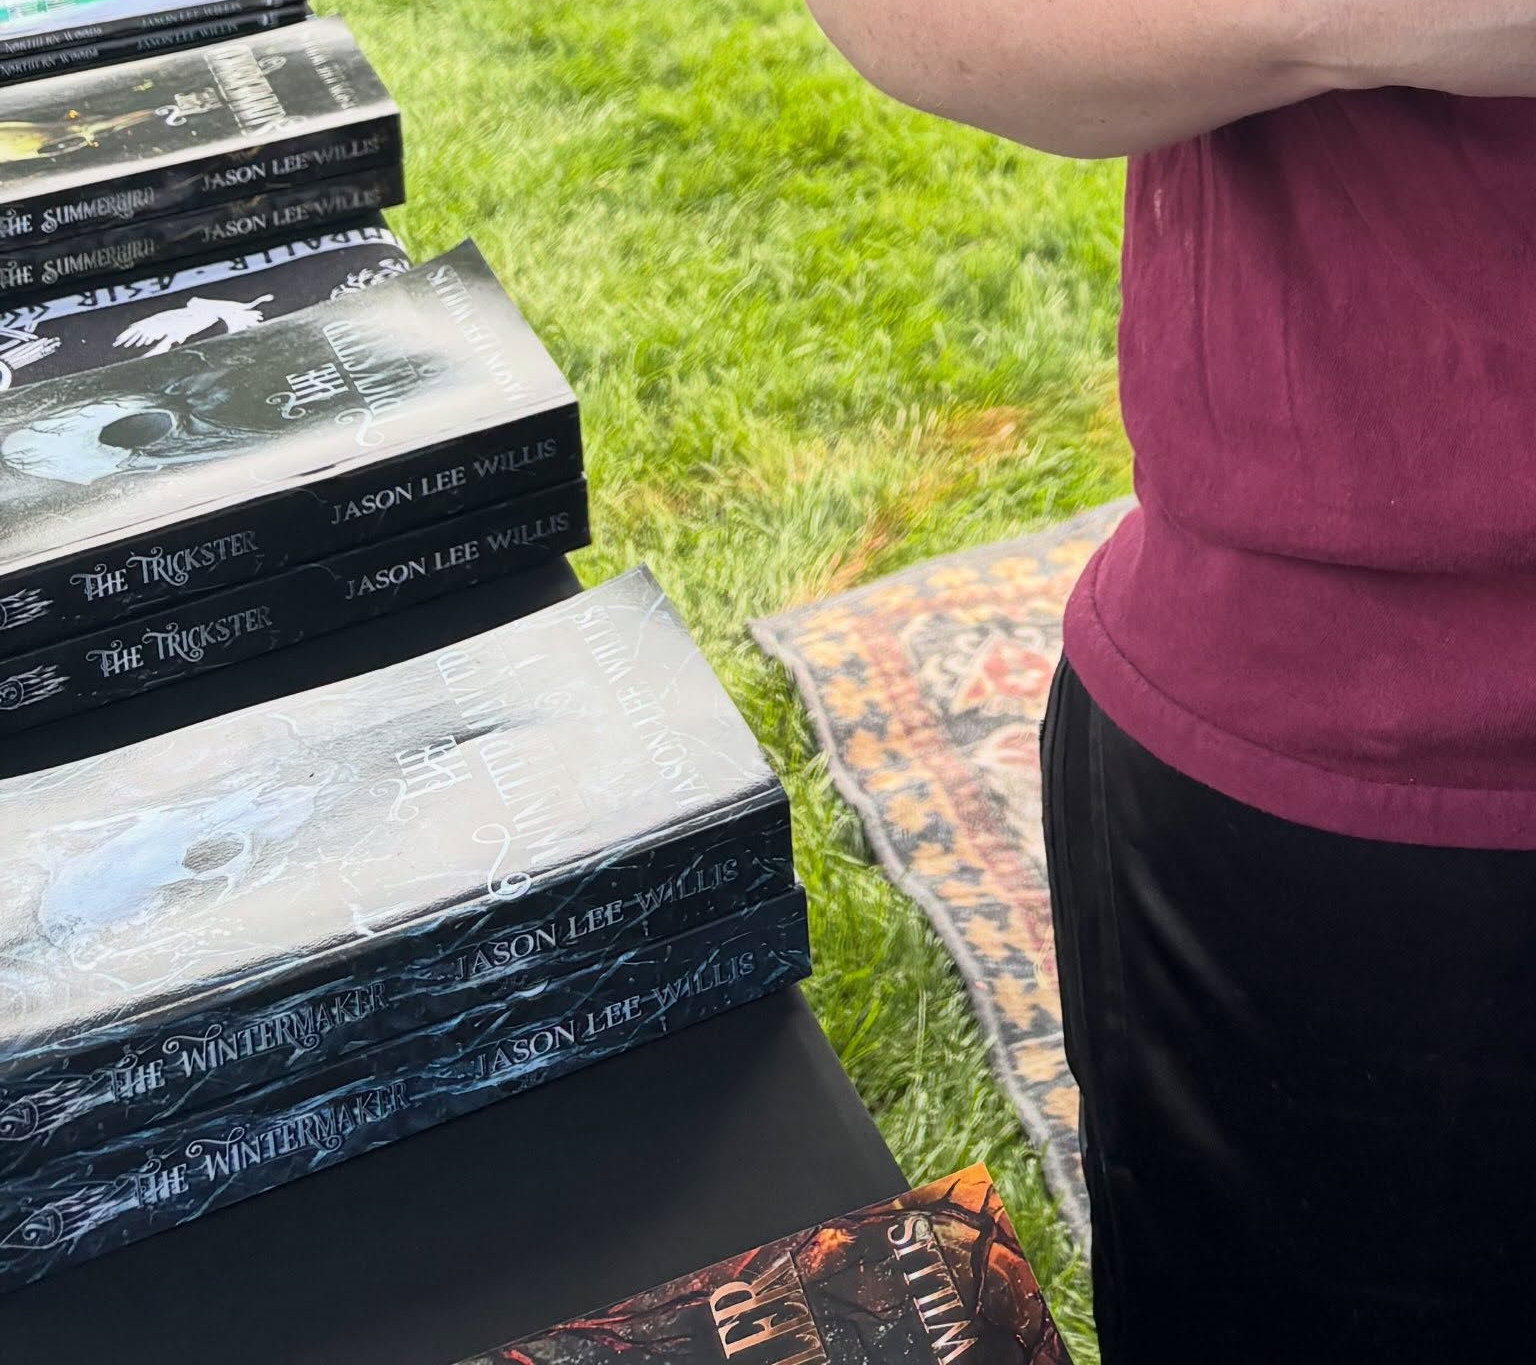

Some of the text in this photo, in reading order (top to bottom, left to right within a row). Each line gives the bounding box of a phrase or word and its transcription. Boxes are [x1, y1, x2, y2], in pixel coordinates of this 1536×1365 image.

[201, 163, 267, 192] JASON
[272, 152, 309, 175] LEE
[308, 138, 382, 167] WILLIS
[201, 214, 267, 244] JASON
[273, 204, 309, 227] LEE
[309, 188, 383, 218] WILLIS
[266, 362, 349, 419] THE
[69, 438, 558, 602] THE TRICKSTER JASON LEE WILLIS
[86, 511, 570, 678] THE TRICKSTER JASON LEE WILLIS
[369, 735, 473, 822] THE
[89, 1053, 166, 1103] THE
[162, 980, 391, 1079] WINTERMAKER
[455, 924, 557, 981] JASON
[567, 900, 625, 940] LEE
[634, 858, 739, 913] WILLIS
[113, 1155, 190, 1209] THE
[185, 1081, 411, 1183] WINTERMAKER
[476, 1020, 576, 1080] JASON
[586, 995, 643, 1038] LEE
[651, 951, 757, 1009] WILLIS
[887, 1216, 980, 1365] WILLIS
